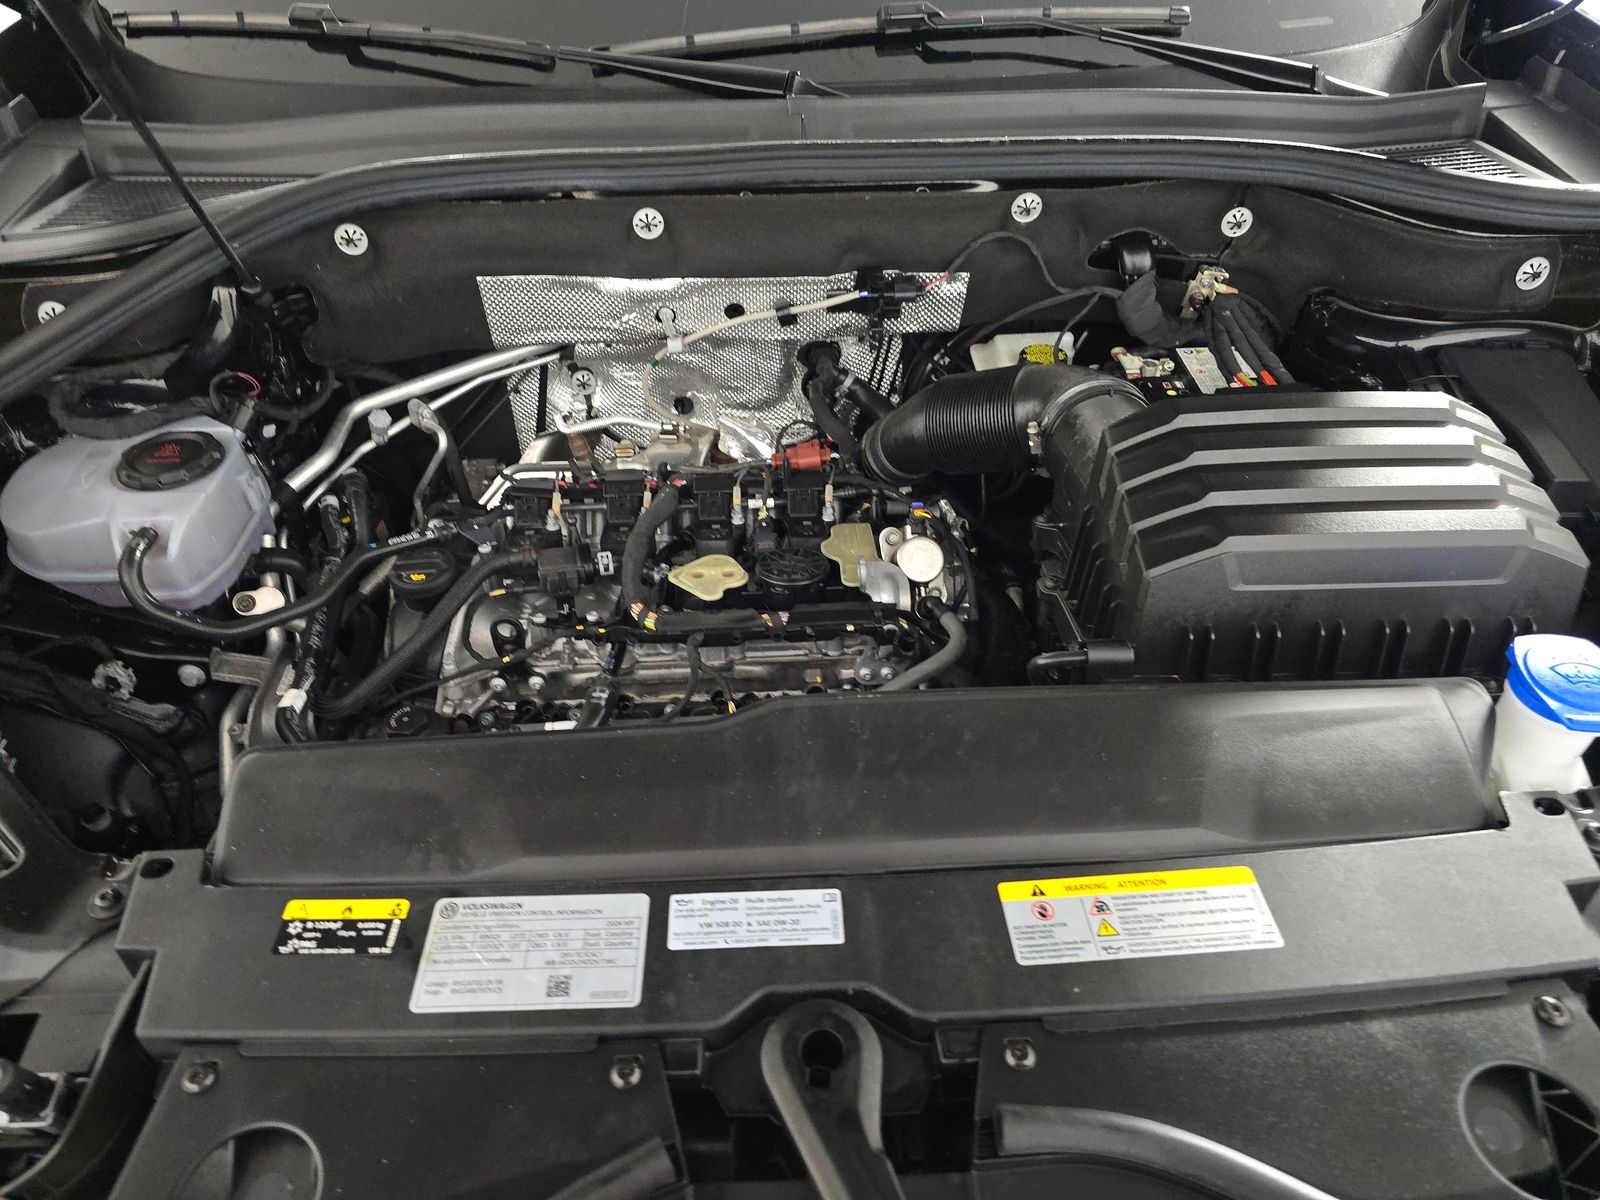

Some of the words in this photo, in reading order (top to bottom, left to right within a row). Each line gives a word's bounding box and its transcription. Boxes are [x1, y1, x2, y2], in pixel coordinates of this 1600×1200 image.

[1063, 882, 1109, 892] WARNING
[1117, 878, 1167, 888] ATTENTION
[461, 902, 523, 910] VOLKSWAGEN
